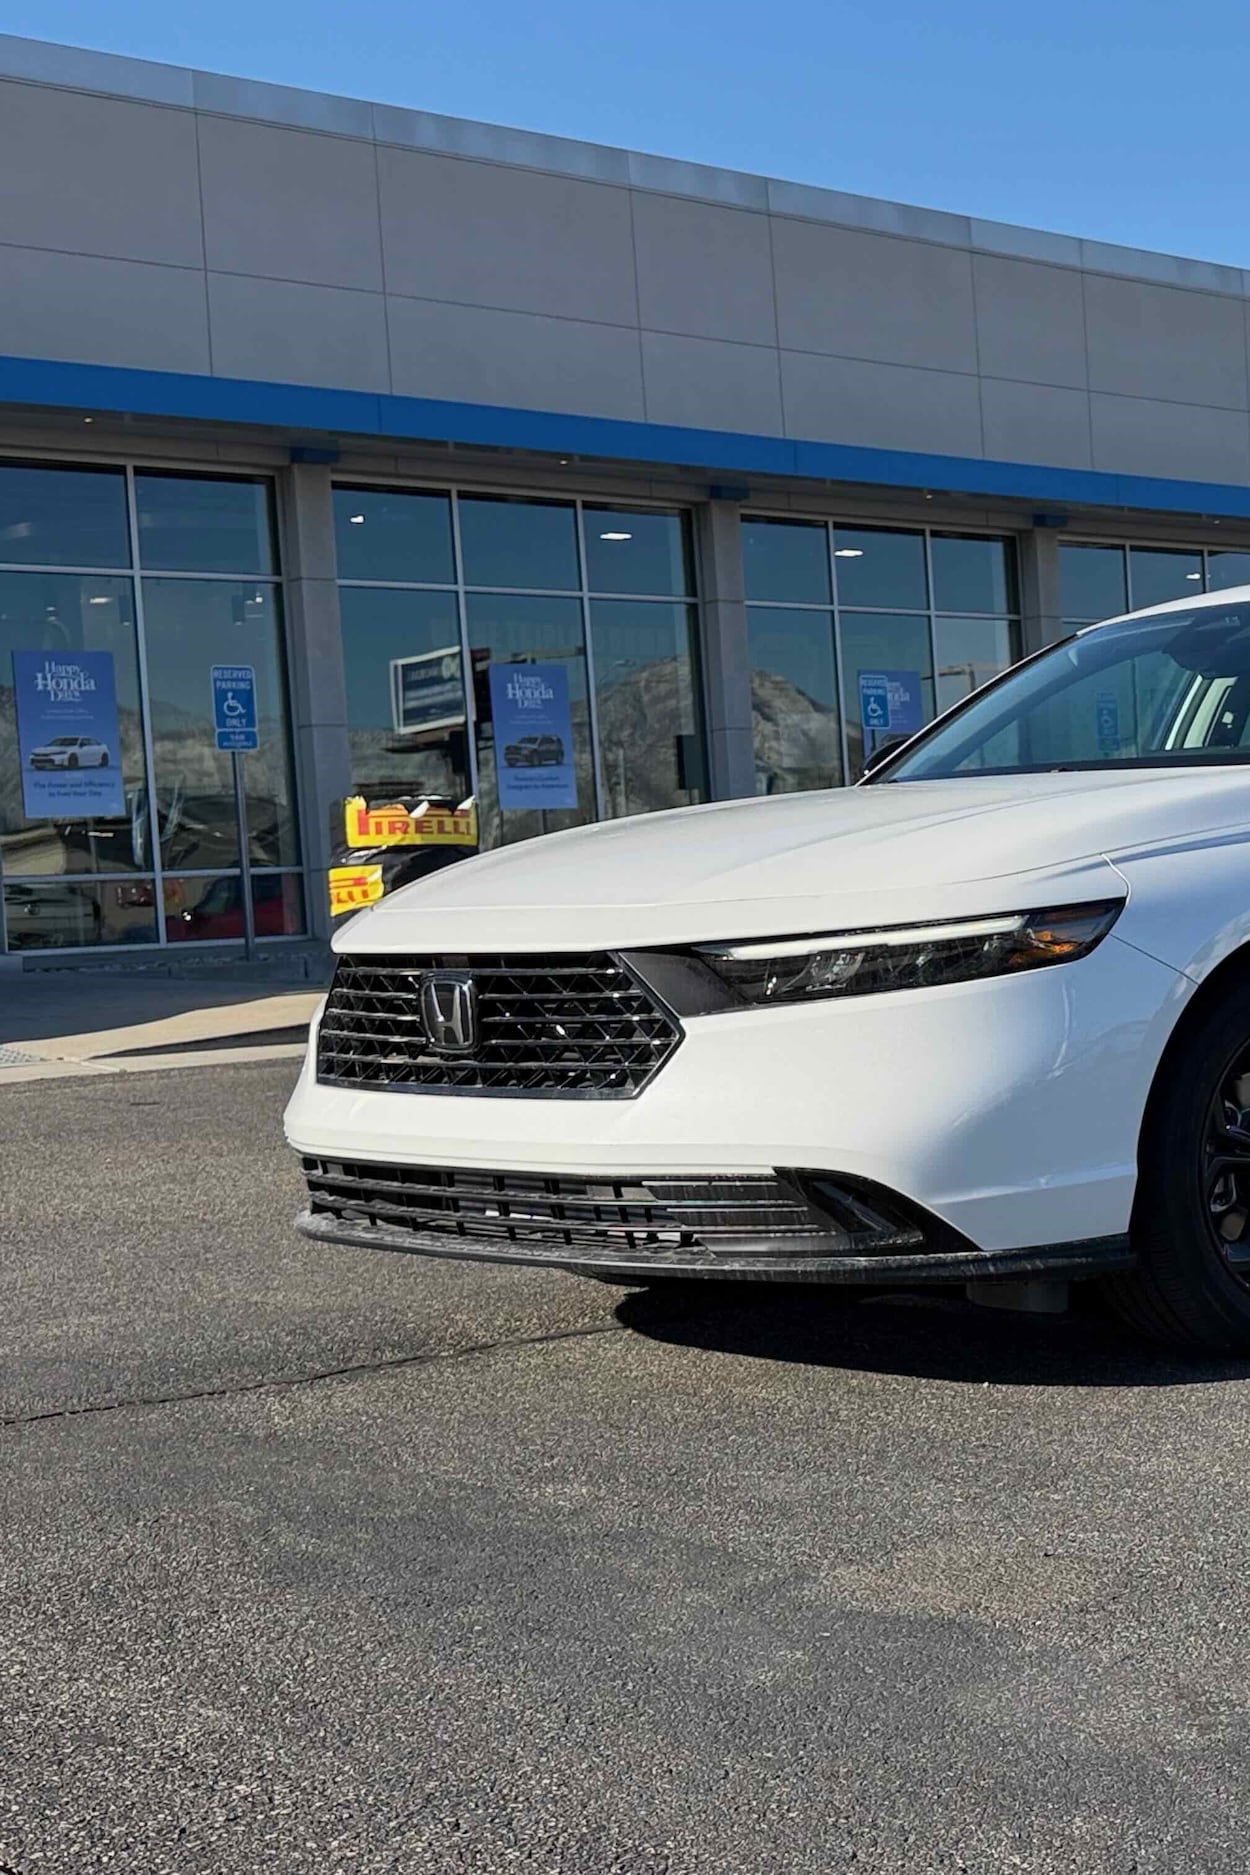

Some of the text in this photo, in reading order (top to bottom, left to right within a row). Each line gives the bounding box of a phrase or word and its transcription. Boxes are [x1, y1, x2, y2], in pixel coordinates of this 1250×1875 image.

[45, 661, 81, 677] Happy
[213, 669, 252, 679] RESERVED
[35, 672, 96, 691] Honda
[216, 681, 251, 690] PARKING
[506, 683, 554, 699] Honda
[225, 718, 247, 727] ONLY
[357, 809, 473, 837] PIRELLI
